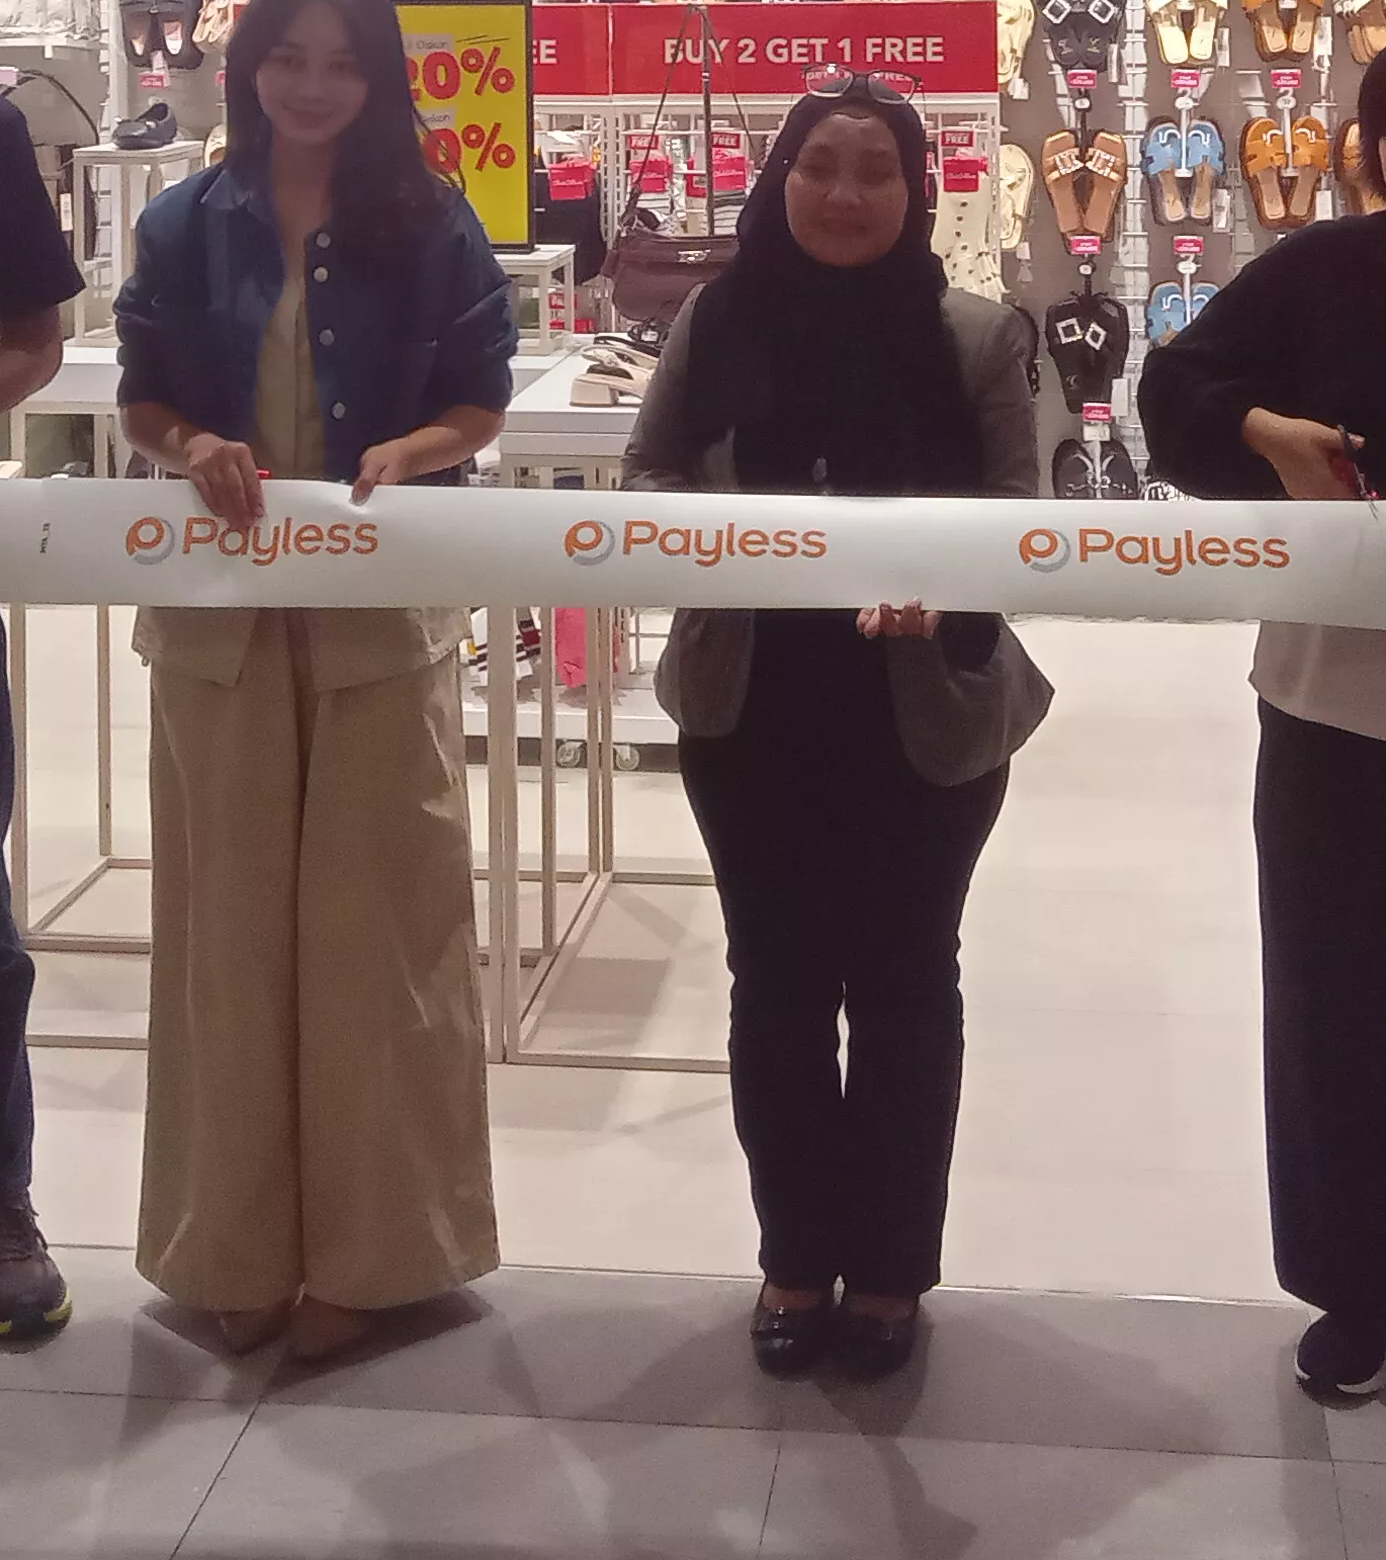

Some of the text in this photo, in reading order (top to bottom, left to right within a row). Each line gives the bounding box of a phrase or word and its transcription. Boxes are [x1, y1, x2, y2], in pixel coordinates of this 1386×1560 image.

[663, 37, 945, 64] BUY 2 GET 1 FREE
[181, 516, 380, 567] Payless
[620, 518, 829, 568] Payless
[1078, 526, 1292, 577] Payless
